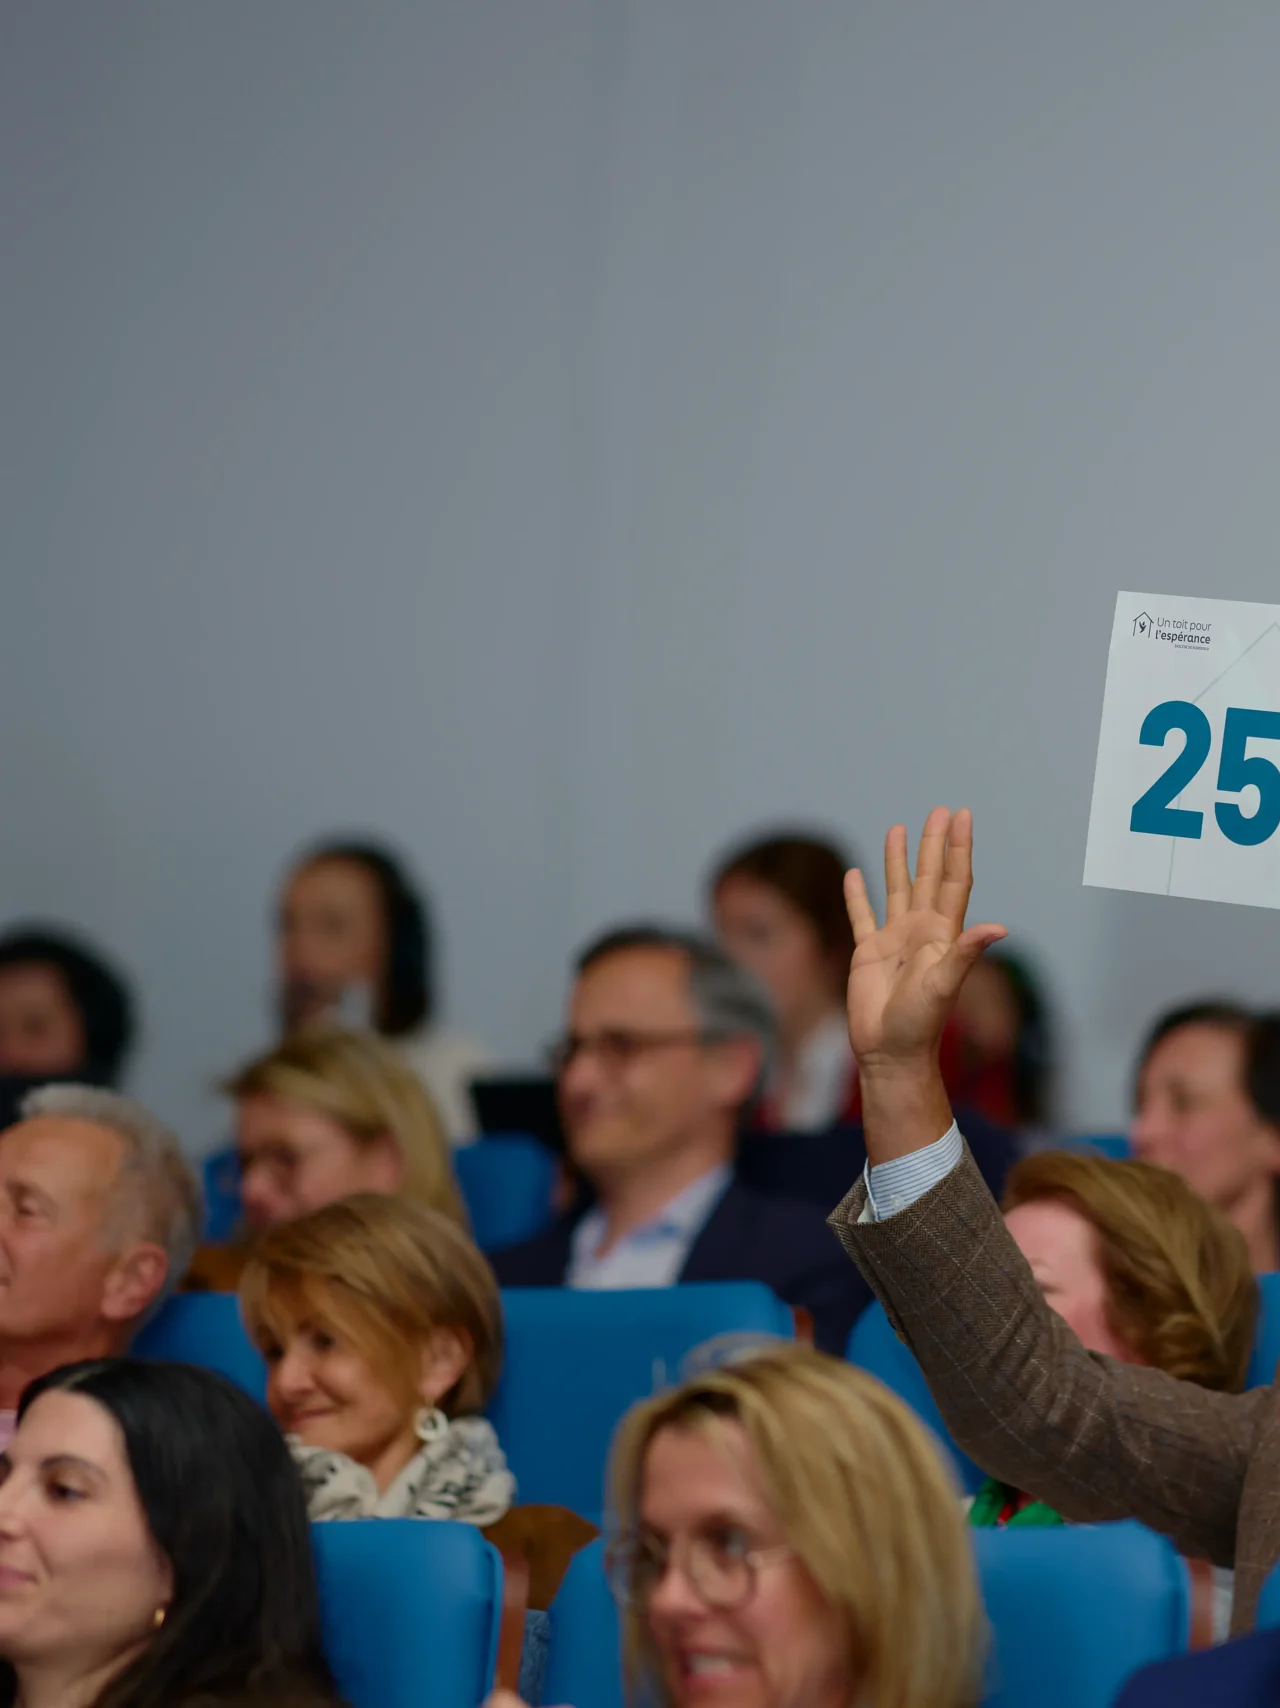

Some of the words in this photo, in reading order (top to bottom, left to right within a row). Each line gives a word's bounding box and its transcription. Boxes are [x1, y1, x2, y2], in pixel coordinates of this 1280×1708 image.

[1157, 617, 1170, 627] Un
[1172, 619, 1188, 629] toit
[1189, 622, 1212, 632] pour
[1155, 629, 1211, 644] l'espérance
